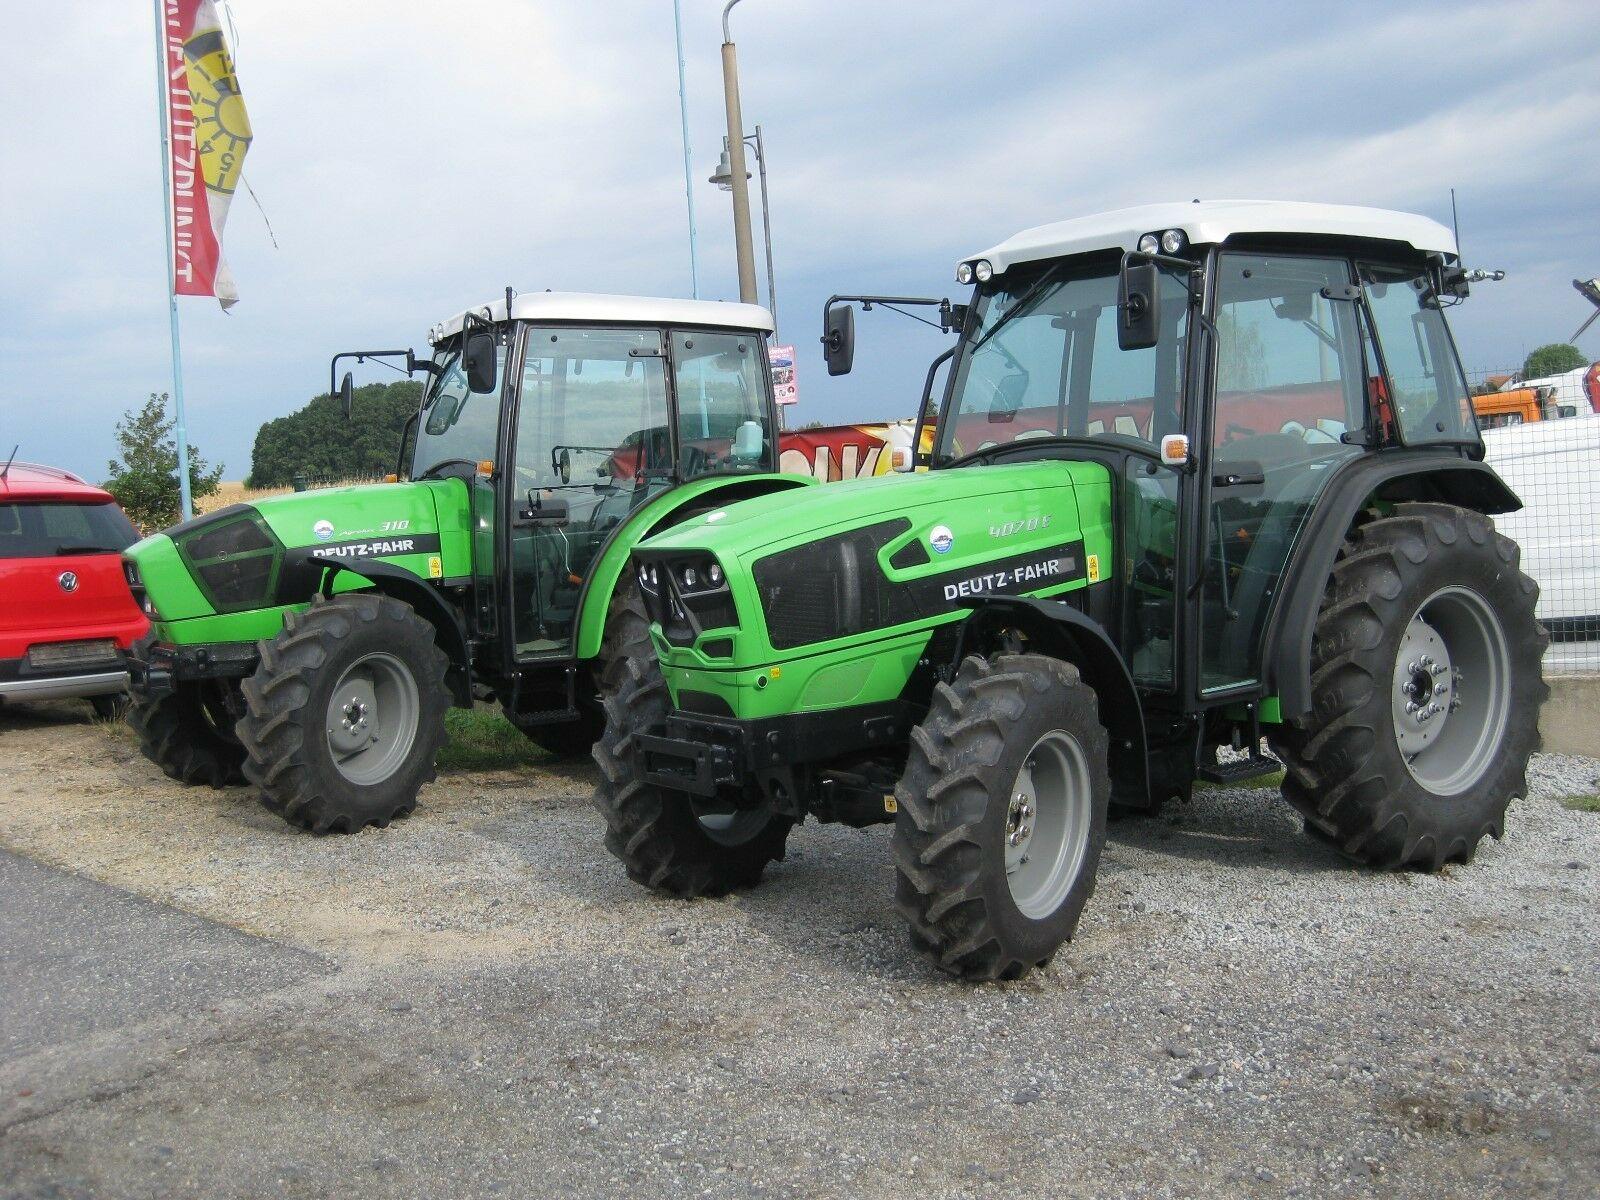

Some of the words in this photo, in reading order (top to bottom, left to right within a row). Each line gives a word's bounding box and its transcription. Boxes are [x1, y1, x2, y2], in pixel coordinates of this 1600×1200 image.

[380, 519, 410, 533] 310
[312, 539, 414, 557] DEUTZ-FAHR
[943, 559, 1060, 601] DEUTZ-FAHR
